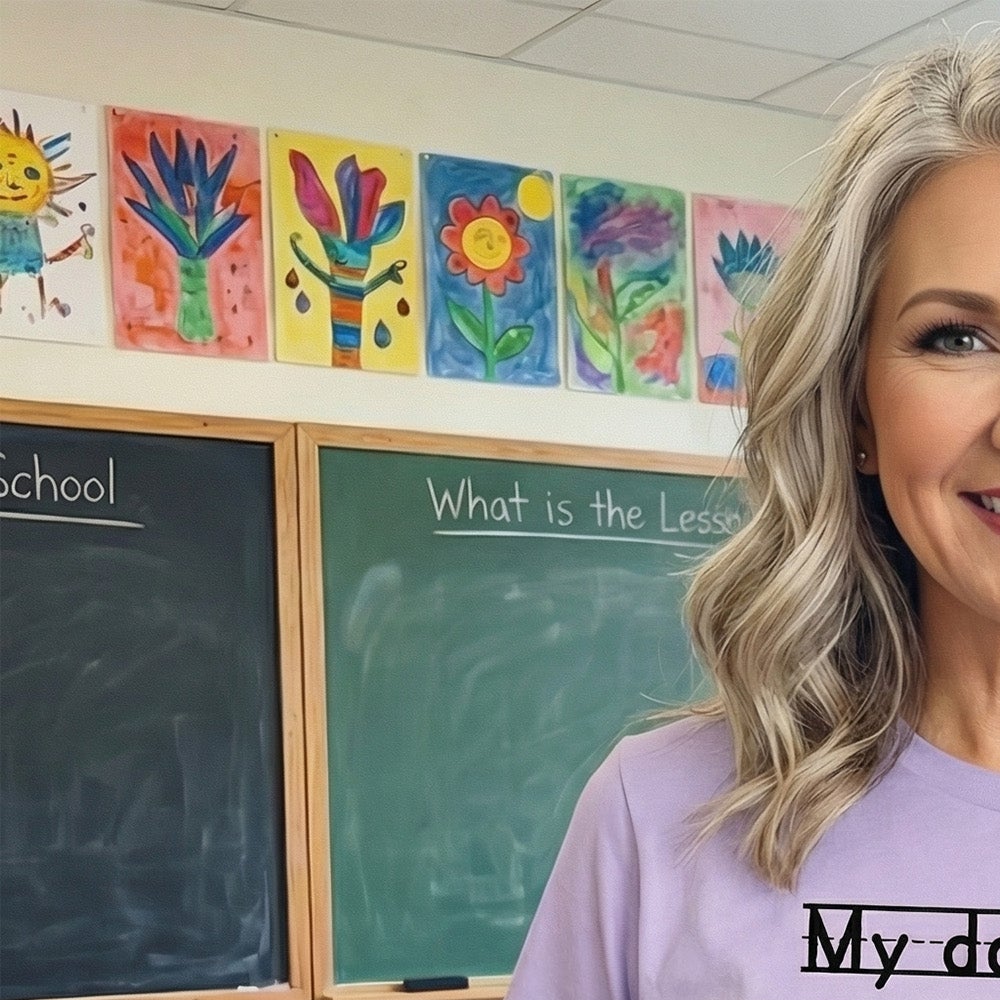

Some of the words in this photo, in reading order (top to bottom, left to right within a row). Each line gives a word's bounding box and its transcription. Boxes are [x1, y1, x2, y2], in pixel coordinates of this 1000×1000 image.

[426, 476, 529, 522] What
[546, 491, 574, 527] is
[589, 488, 645, 530] the
[808, 907, 909, 989] My
